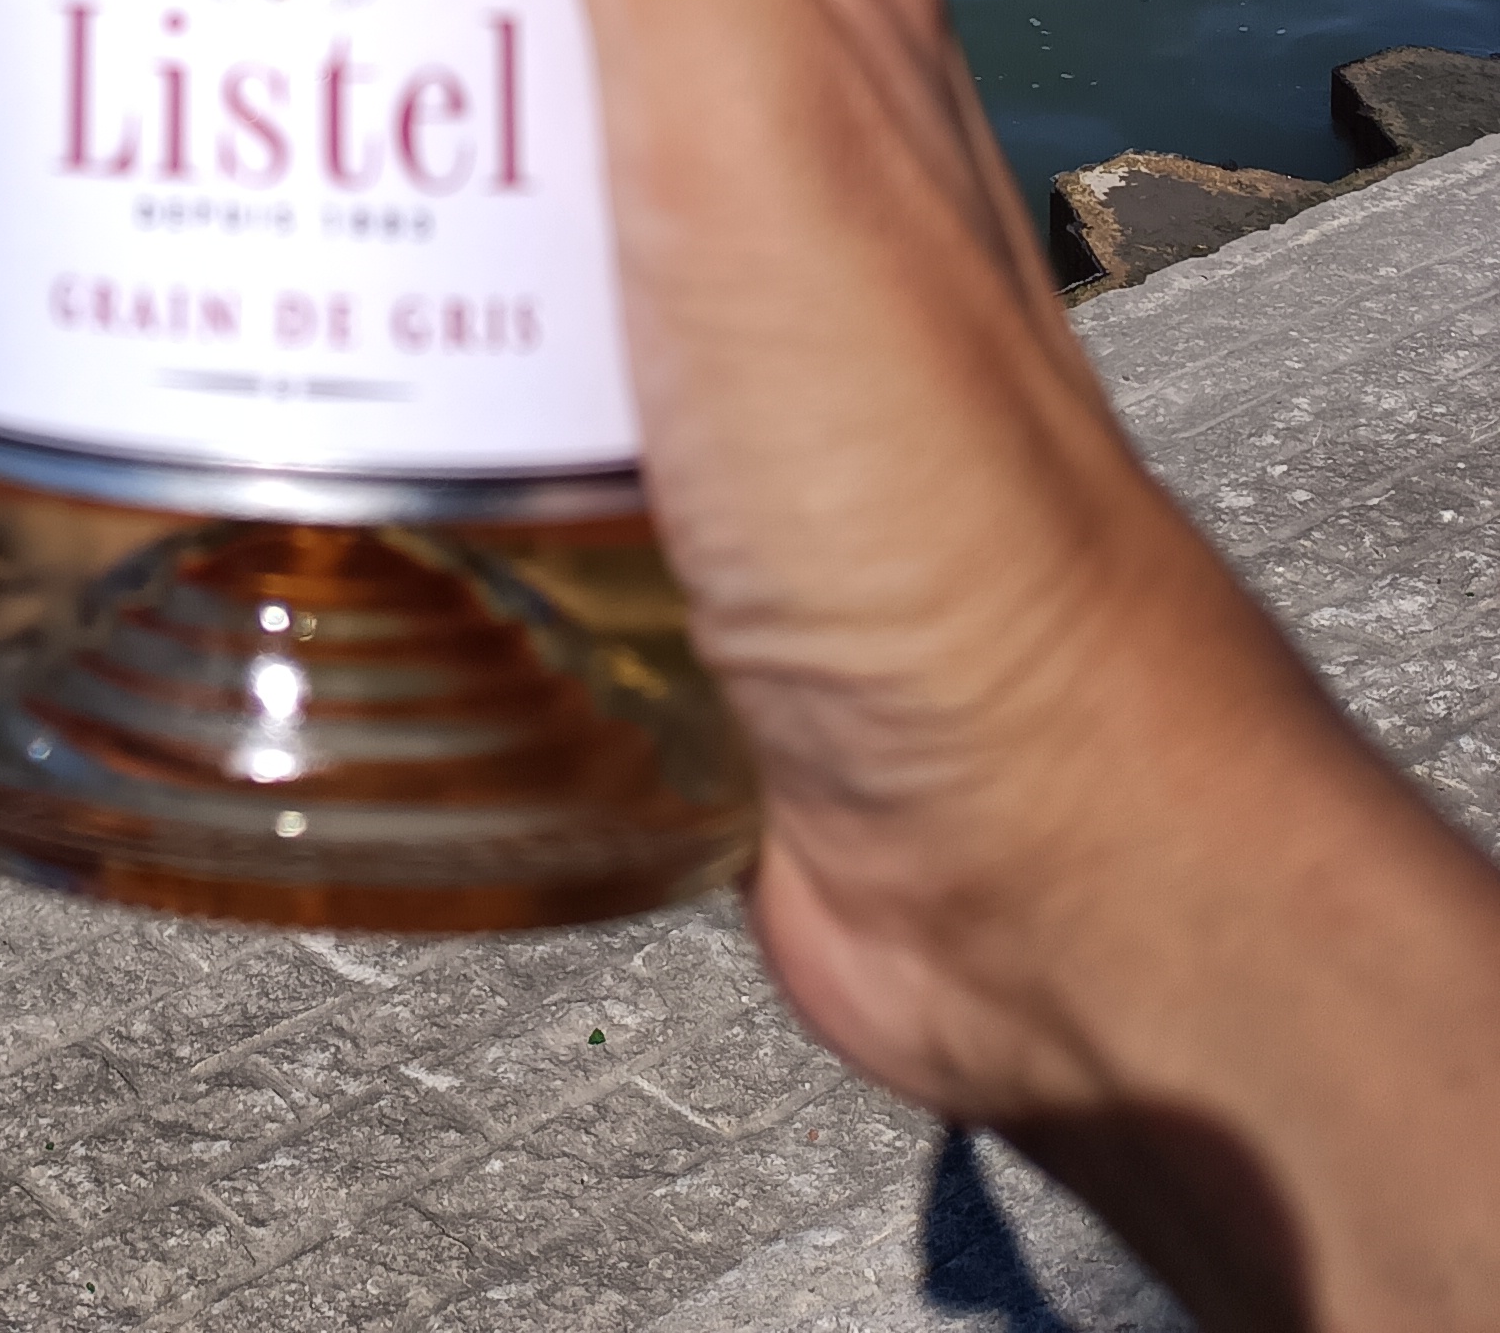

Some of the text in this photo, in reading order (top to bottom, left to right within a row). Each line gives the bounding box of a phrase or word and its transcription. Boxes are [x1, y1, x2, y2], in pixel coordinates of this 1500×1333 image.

[50, 274, 541, 351] GRAIN DE GRIS
